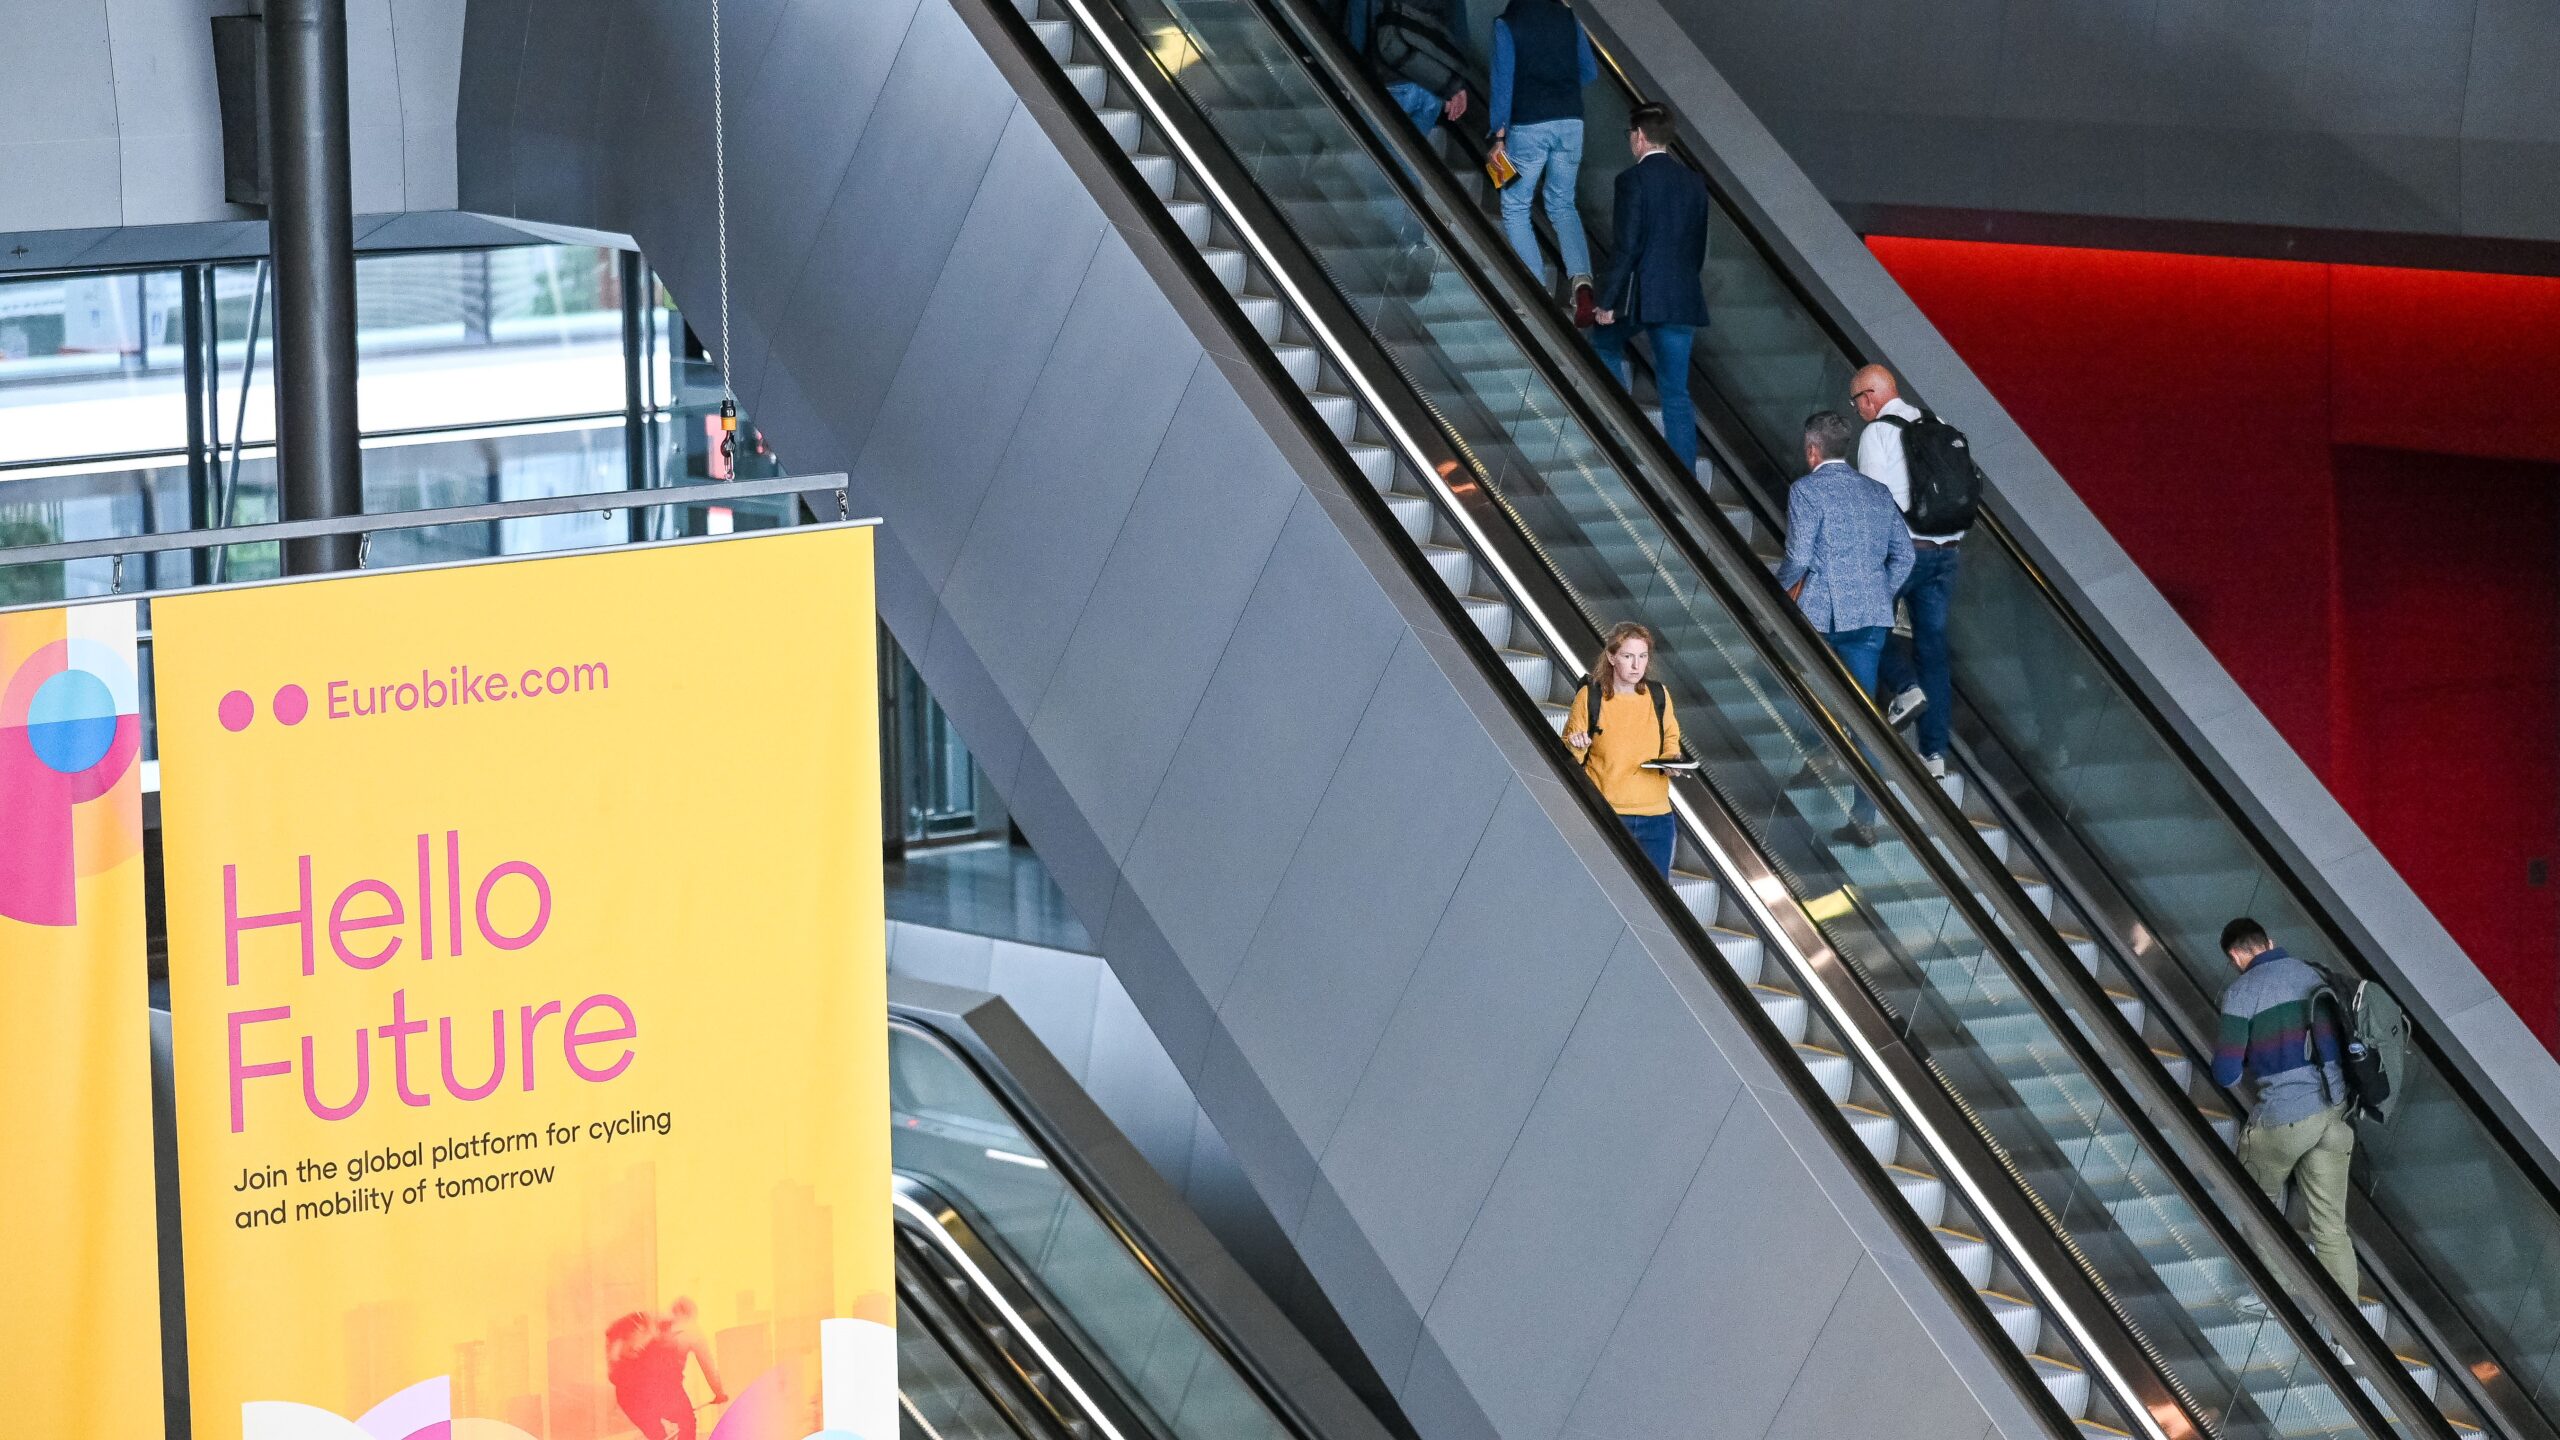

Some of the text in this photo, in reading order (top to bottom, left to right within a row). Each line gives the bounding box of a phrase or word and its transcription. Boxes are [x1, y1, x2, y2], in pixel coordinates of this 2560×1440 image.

[726, 409, 734, 417] 10
[328, 662, 609, 719] Eurobike.com
[223, 830, 551, 985] Hello
[228, 989, 637, 1133] Future
[233, 1110, 671, 1192] Join the global platform for cycling
[235, 1166, 555, 1229] and mobility of tomorrow
